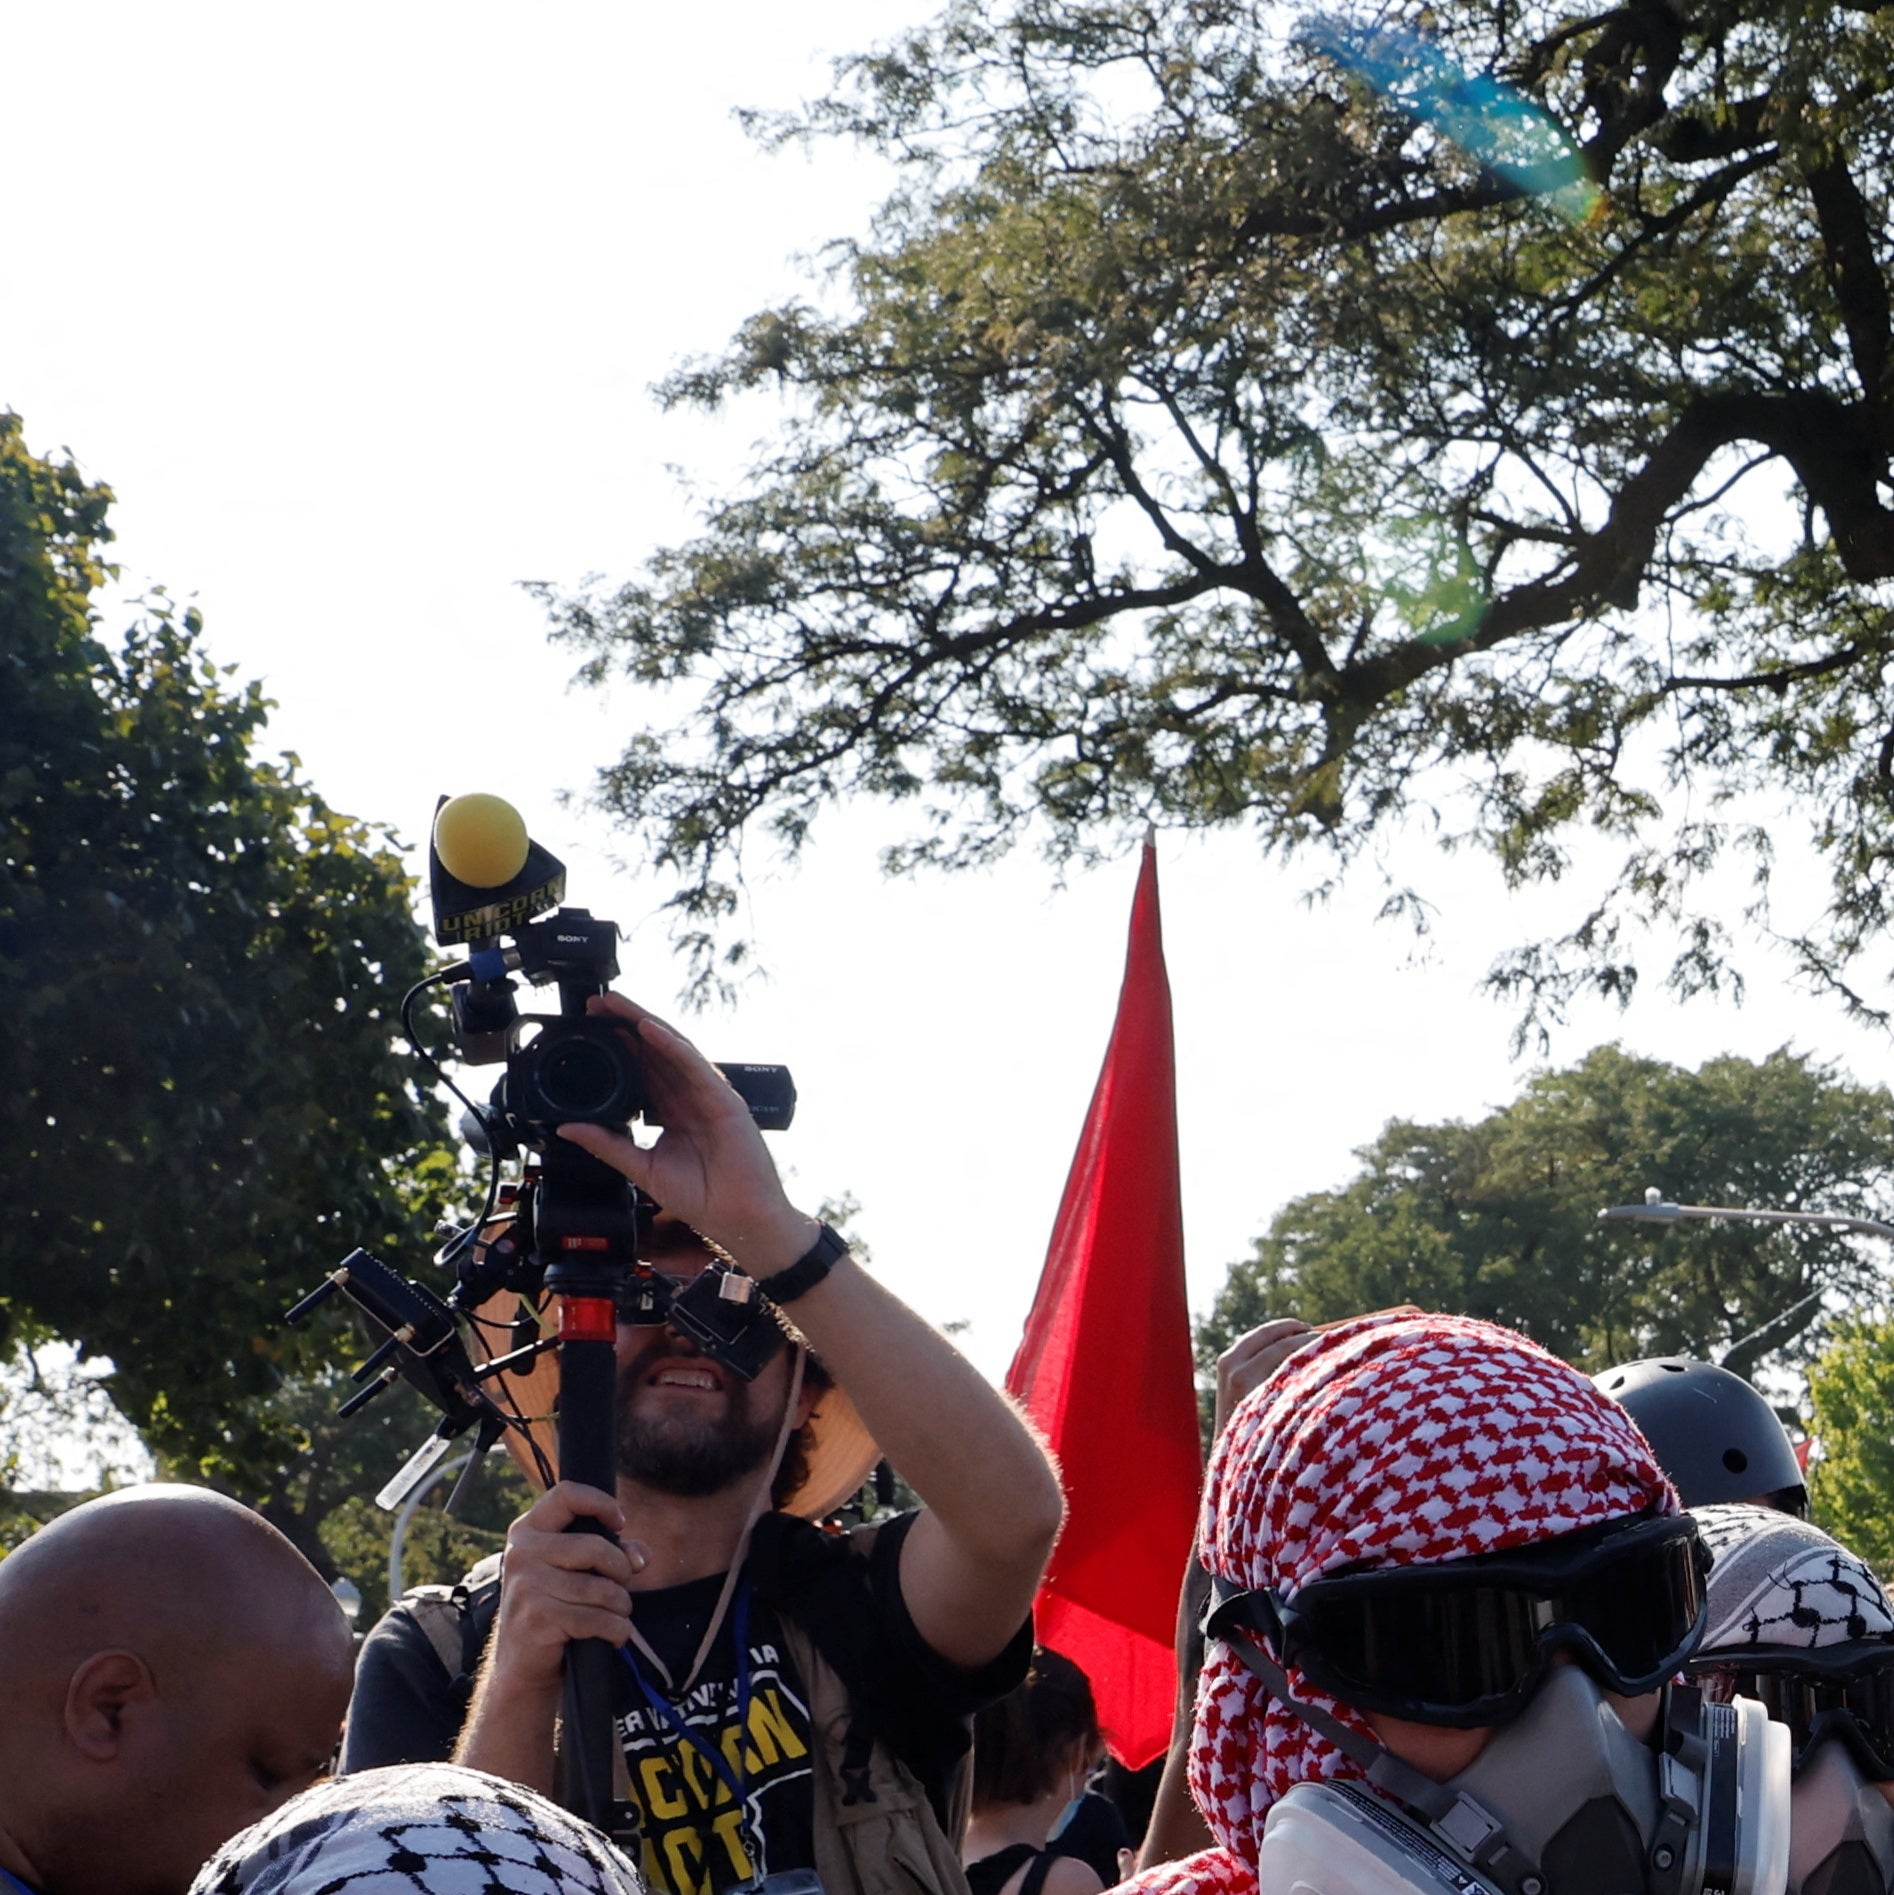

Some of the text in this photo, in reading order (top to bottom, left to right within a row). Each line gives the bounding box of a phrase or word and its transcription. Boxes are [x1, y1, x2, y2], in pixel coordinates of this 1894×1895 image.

[443, 874, 565, 932] UNICORN
[464, 912, 526, 942] RIOT
[557, 935, 589, 943] SONY
[744, 1065, 778, 1073] SONY
